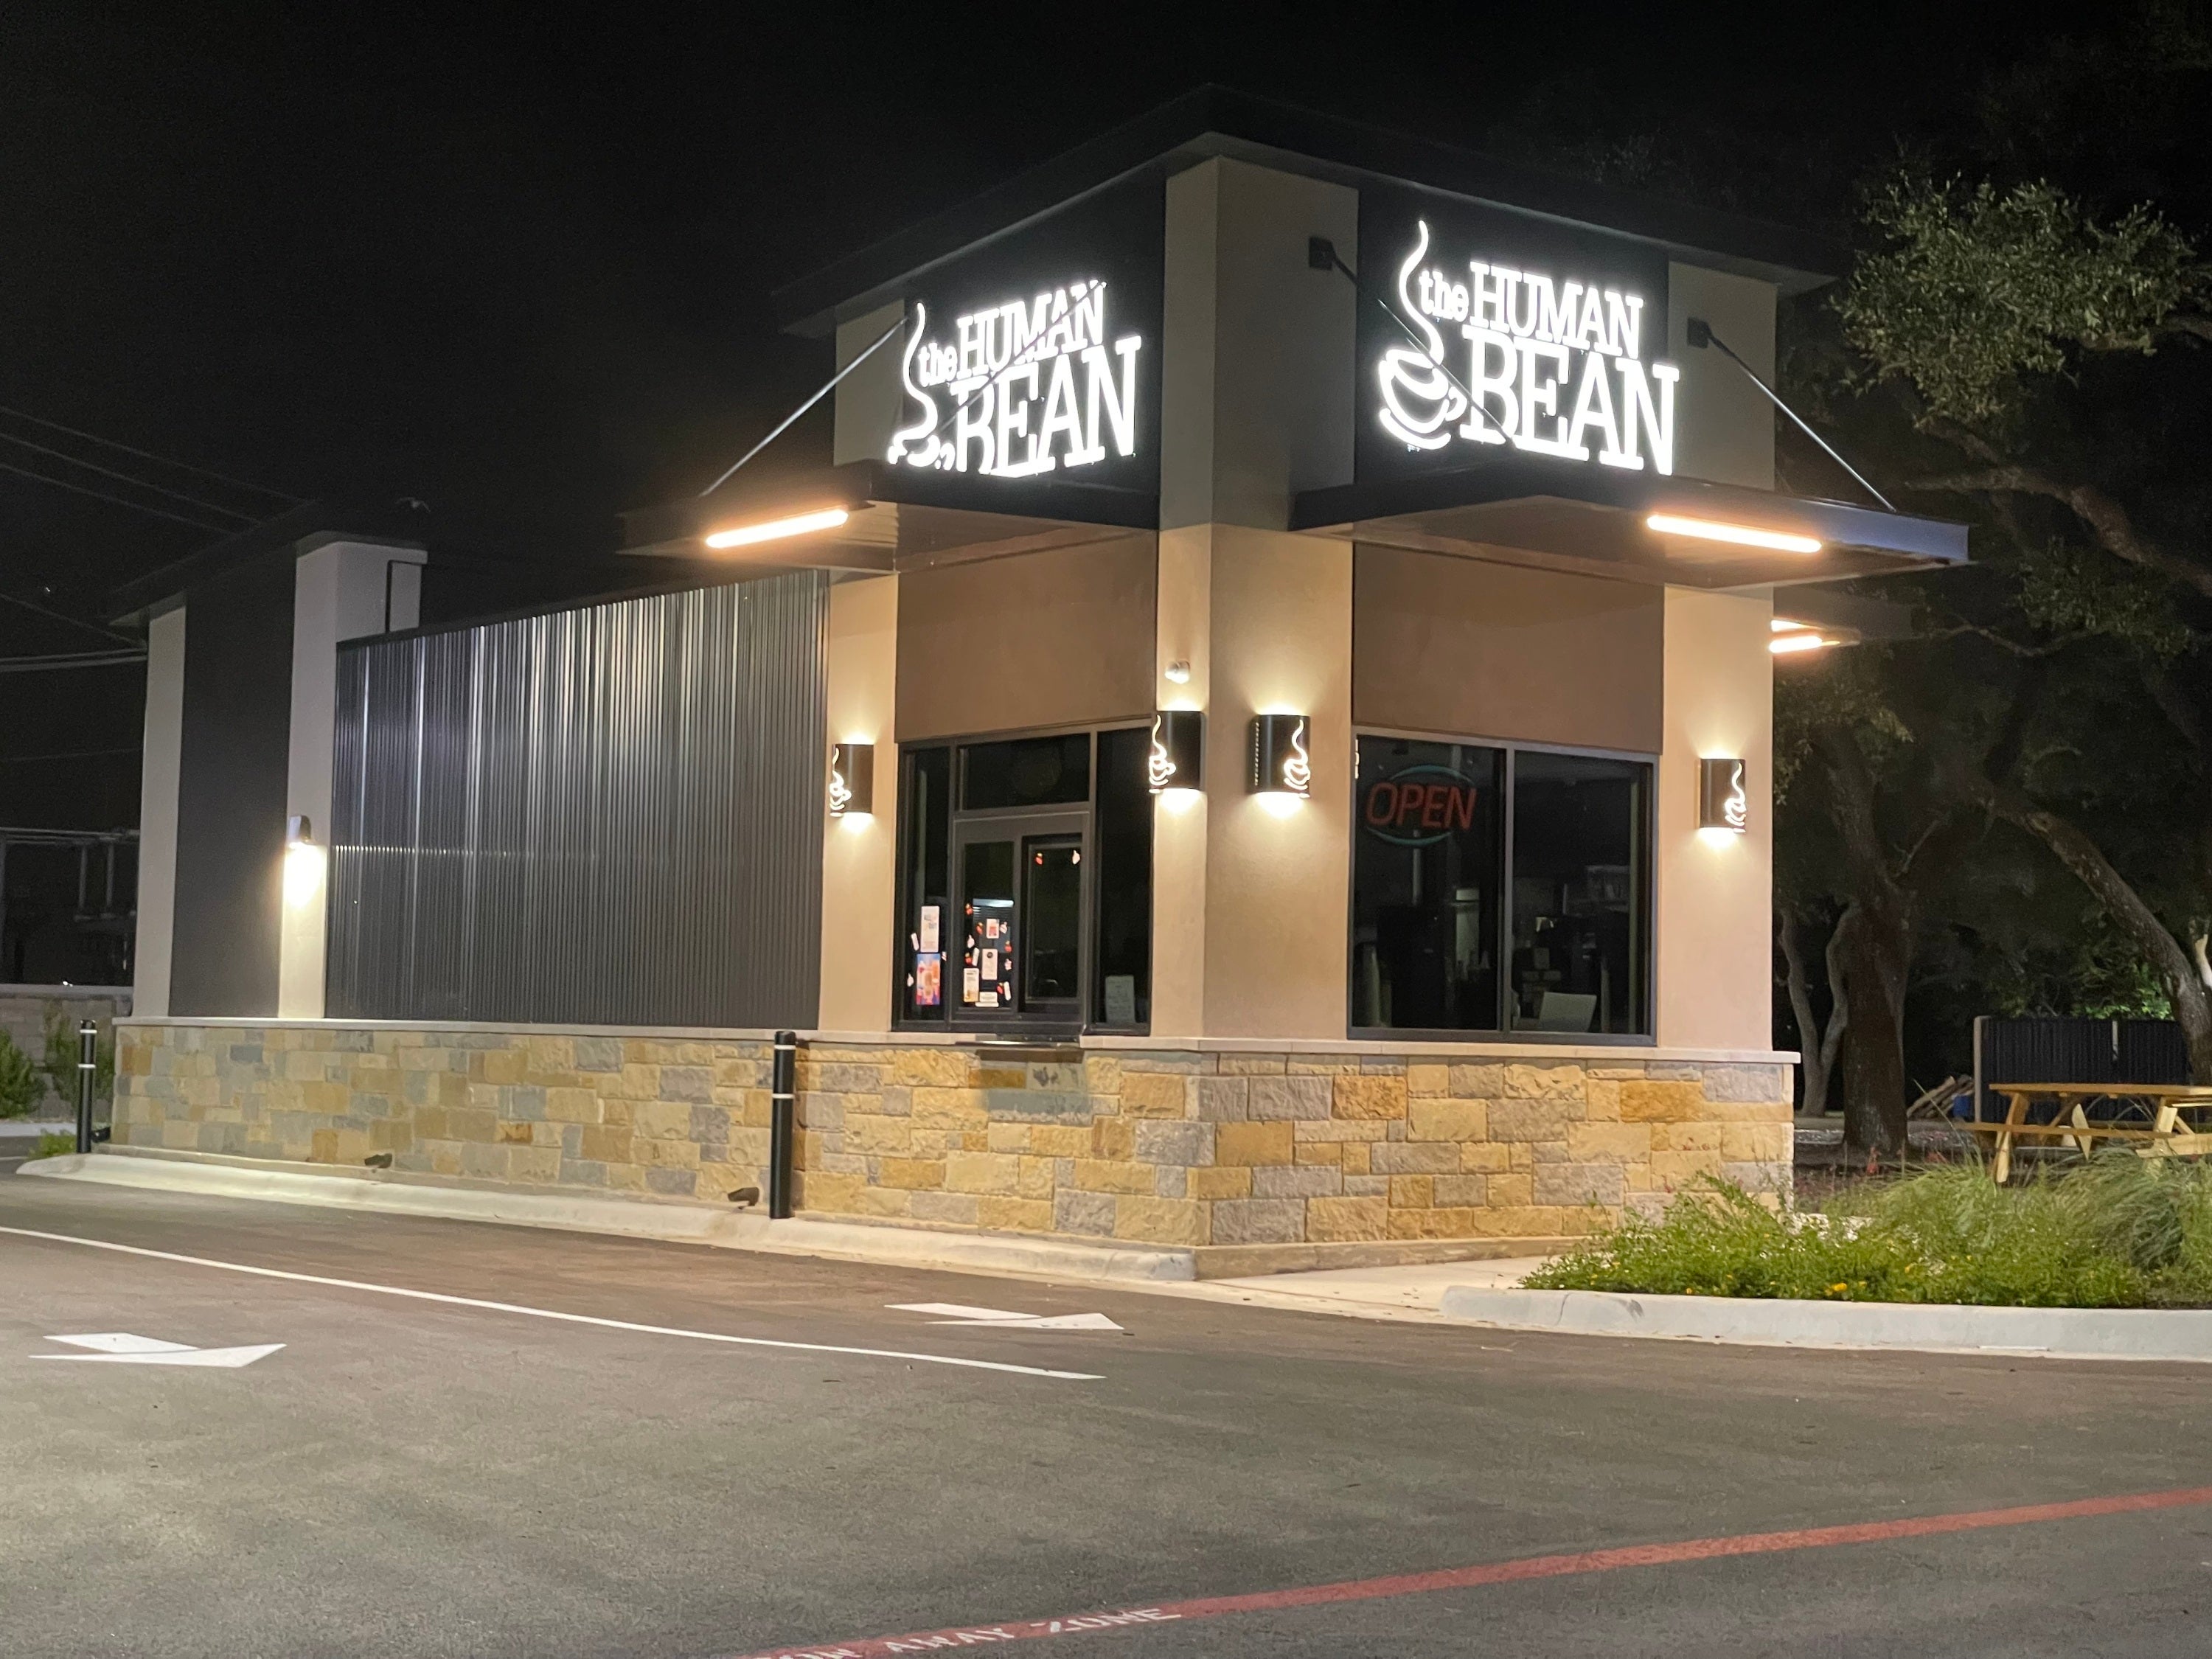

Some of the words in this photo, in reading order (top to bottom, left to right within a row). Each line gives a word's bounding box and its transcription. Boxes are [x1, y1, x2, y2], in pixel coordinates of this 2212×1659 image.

[918, 342, 957, 387] the
[956, 279, 1107, 376] HUMAN
[1419, 270, 1470, 322] the
[1470, 261, 1644, 360] HUMAN
[950, 335, 1141, 478] BEAN
[1459, 324, 1680, 476] BEAN
[1366, 782, 1478, 831] OPEN
[884, 1628, 1015, 1652] AWAY
[1029, 1608, 1181, 1633] ZONE
